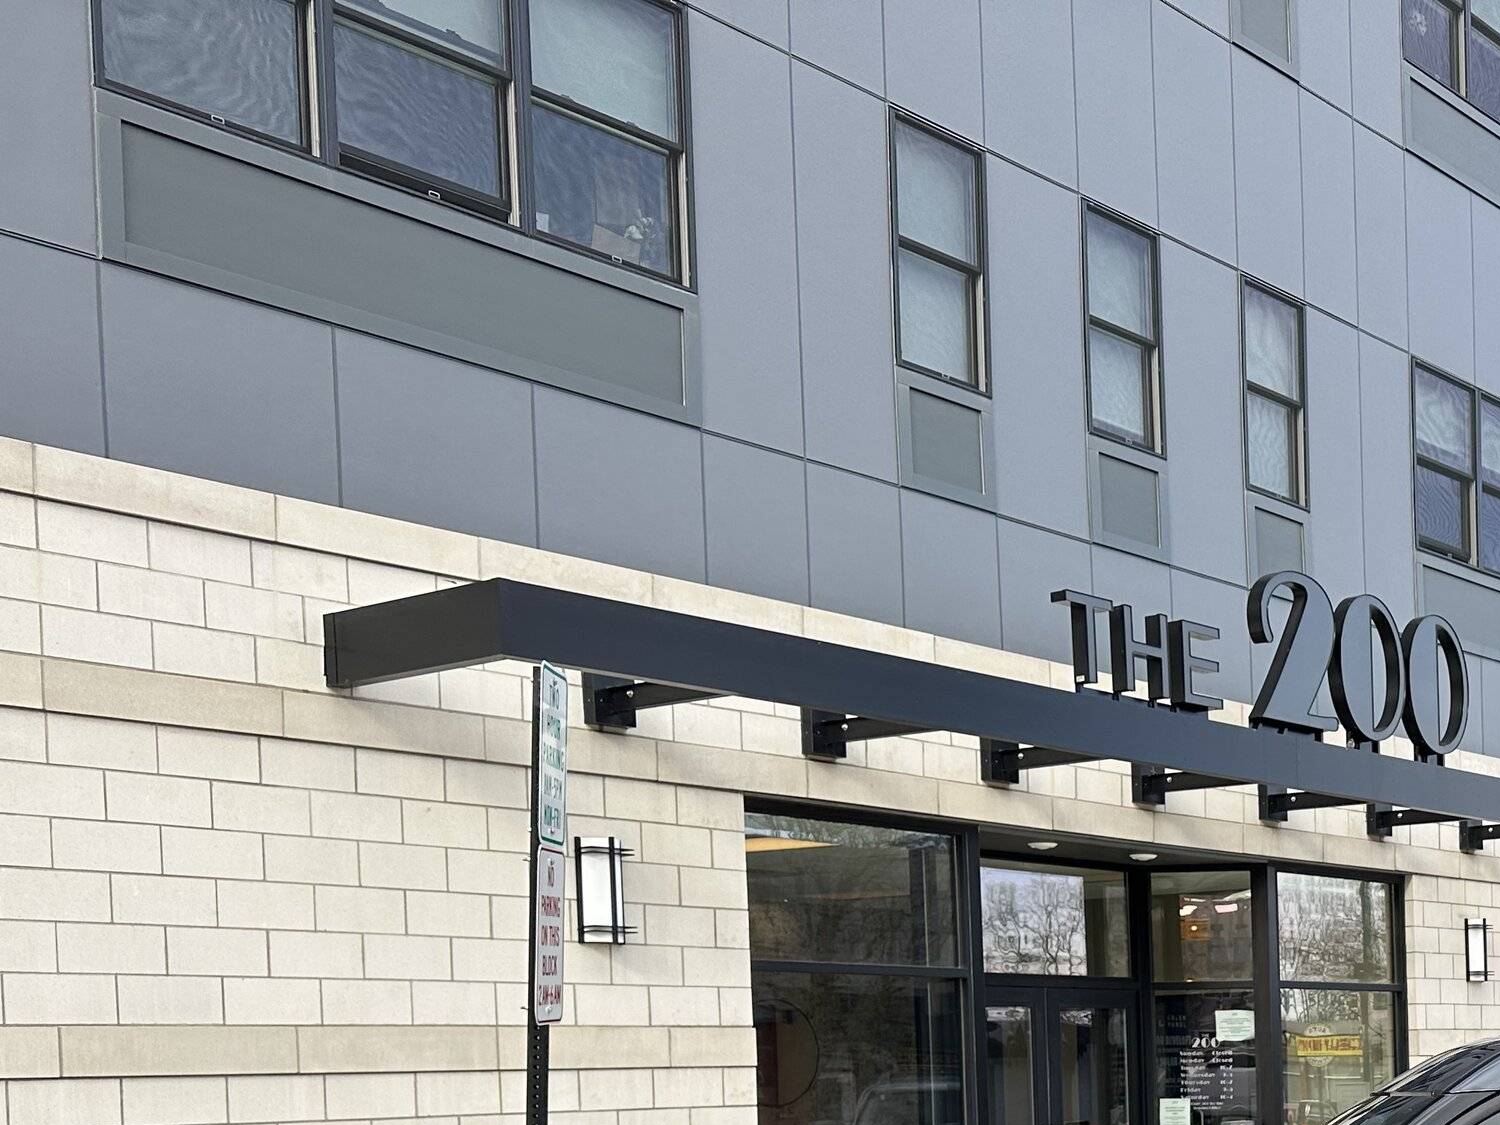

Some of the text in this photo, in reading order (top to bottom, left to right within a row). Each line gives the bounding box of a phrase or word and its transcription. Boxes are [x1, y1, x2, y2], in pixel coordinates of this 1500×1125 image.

[1050, 570, 1469, 754] THE 200
[549, 684, 560, 710] TWO
[543, 742, 564, 772] PARKING
[547, 865, 555, 887] NO
[541, 894, 560, 917] PARKING
[541, 925, 560, 947] ON THIS
[542, 954, 558, 976] BLOCK
[1191, 1037, 1220, 1048] 200
